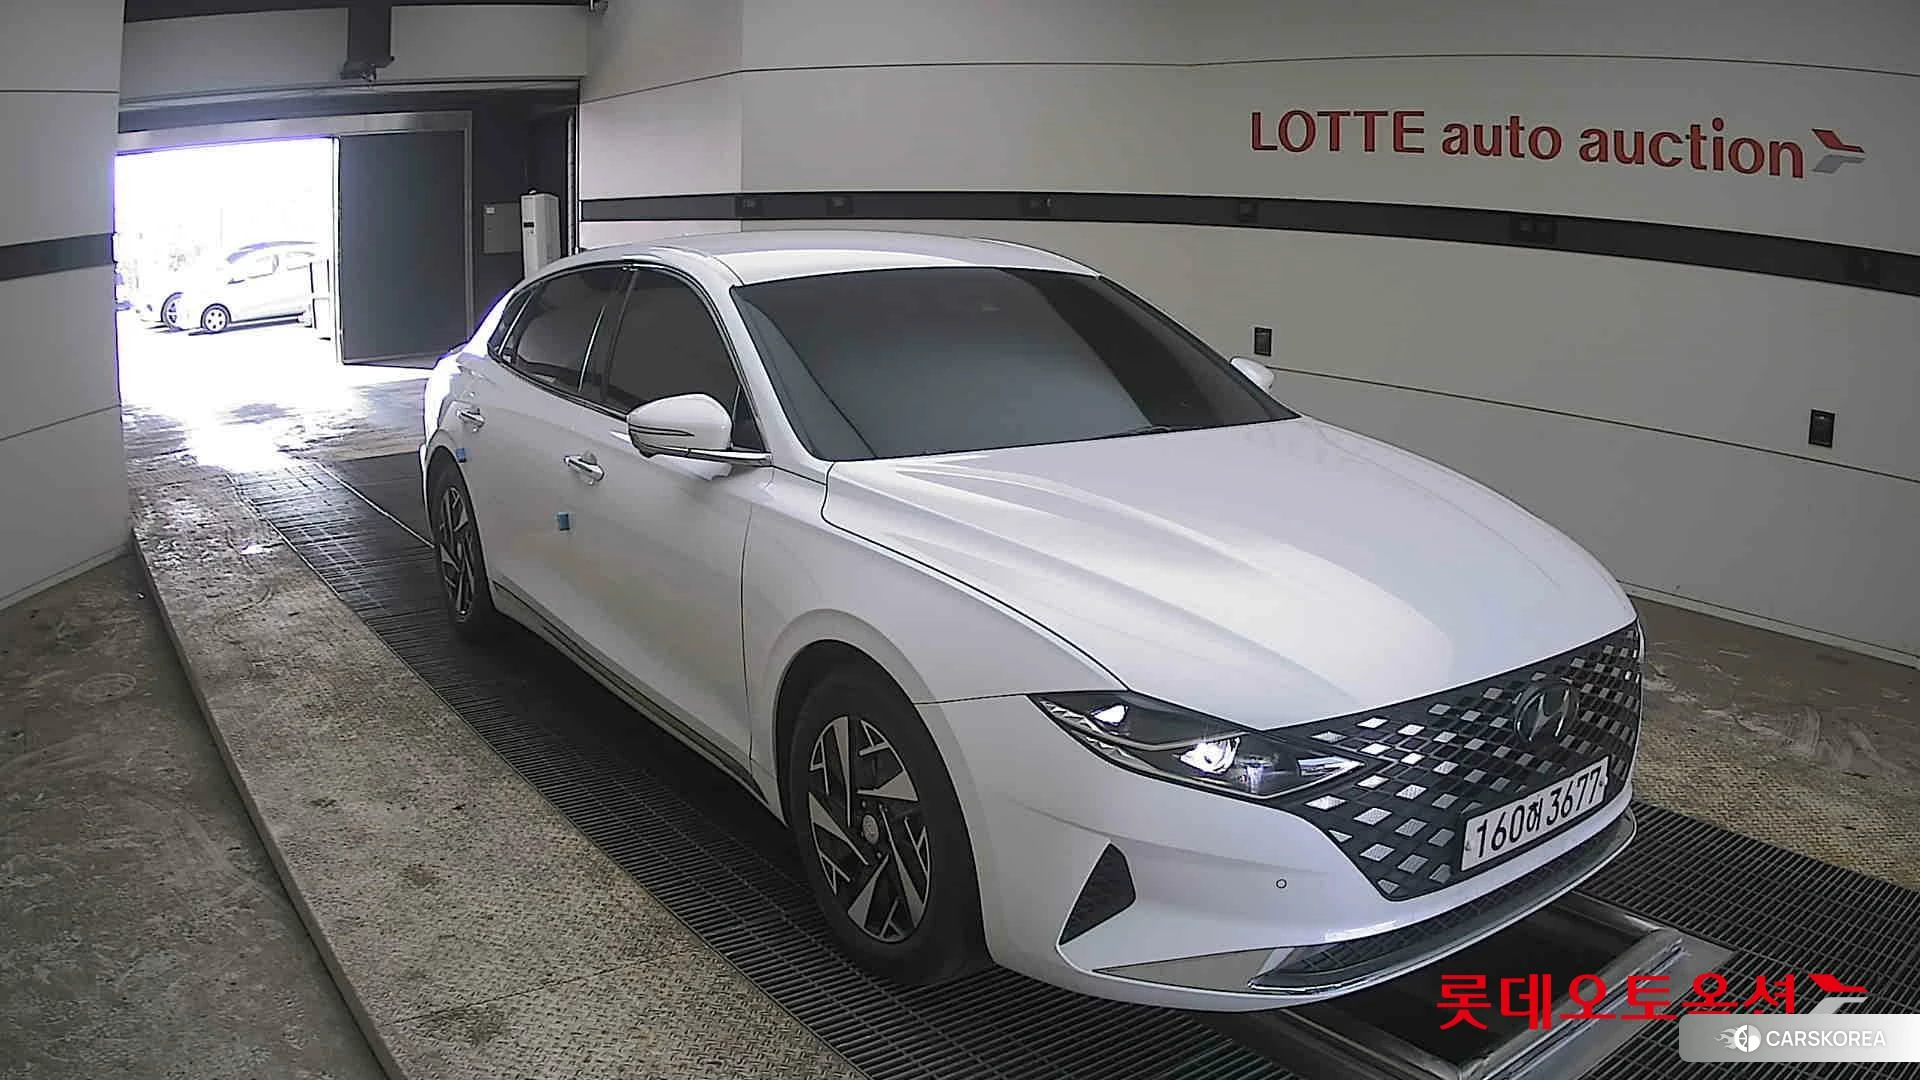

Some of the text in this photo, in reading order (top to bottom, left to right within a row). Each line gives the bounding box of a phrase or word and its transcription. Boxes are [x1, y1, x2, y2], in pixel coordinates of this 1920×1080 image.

[1251, 110, 1804, 178] LOTTE auto auction
[1546, 765, 1603, 827] 3677
